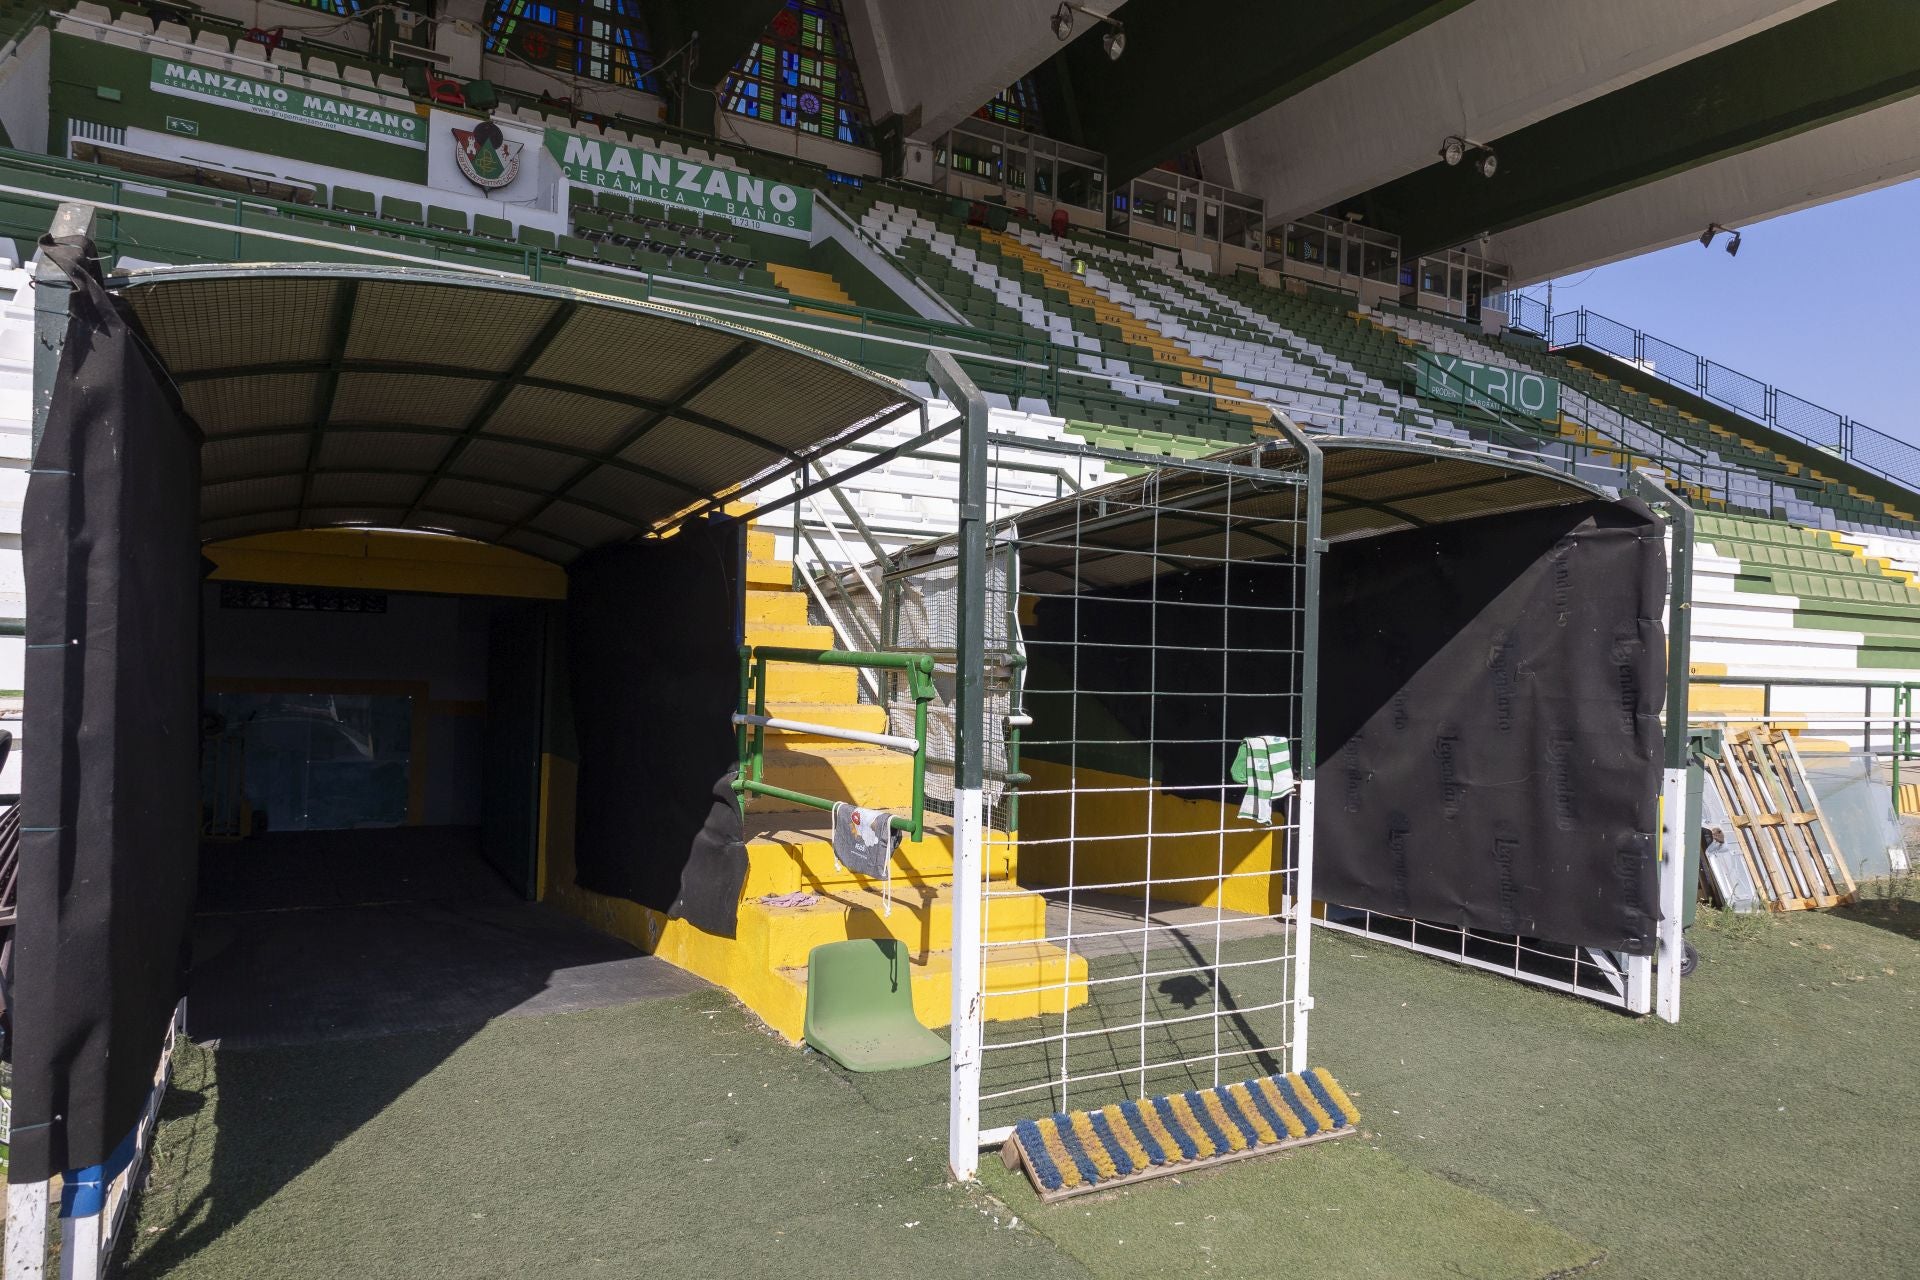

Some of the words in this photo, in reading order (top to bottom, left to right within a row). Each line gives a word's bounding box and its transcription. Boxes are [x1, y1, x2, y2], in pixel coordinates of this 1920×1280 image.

[165, 63, 288, 102] MANZANO
[303, 95, 416, 131] MANZANO
[563, 135, 797, 212] MANZANO
[562, 165, 685, 203] CERÁMICA
[702, 196, 710, 208] Y
[727, 202, 795, 227] BAÑOS
[752, 221, 761, 229] 10
